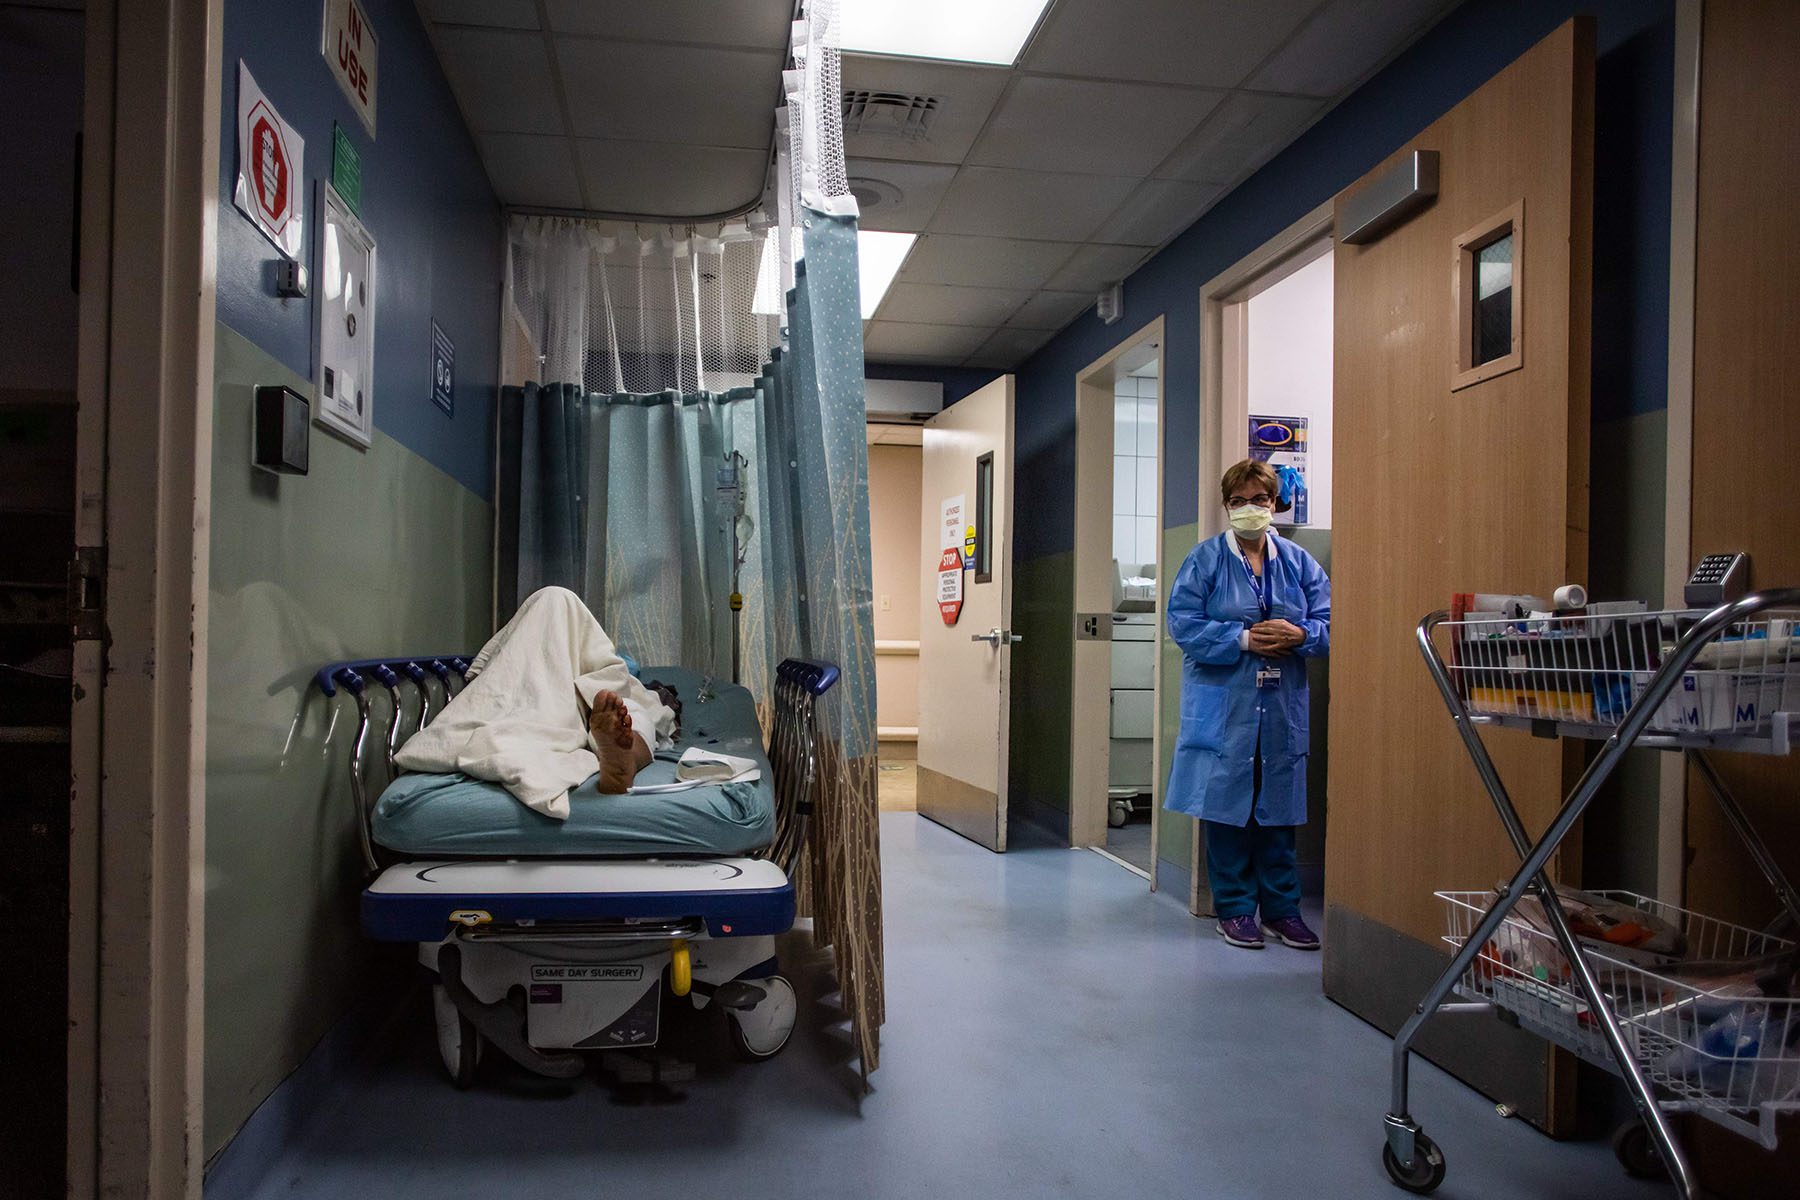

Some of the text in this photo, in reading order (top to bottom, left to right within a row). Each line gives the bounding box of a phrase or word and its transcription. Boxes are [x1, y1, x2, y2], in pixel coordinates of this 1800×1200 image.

[349, 0, 362, 52] IN
[339, 29, 368, 106] USE
[943, 552, 957, 566] STOP
[1737, 703, 1755, 722] M
[535, 968, 638, 977] SAME DAY SURGERY
